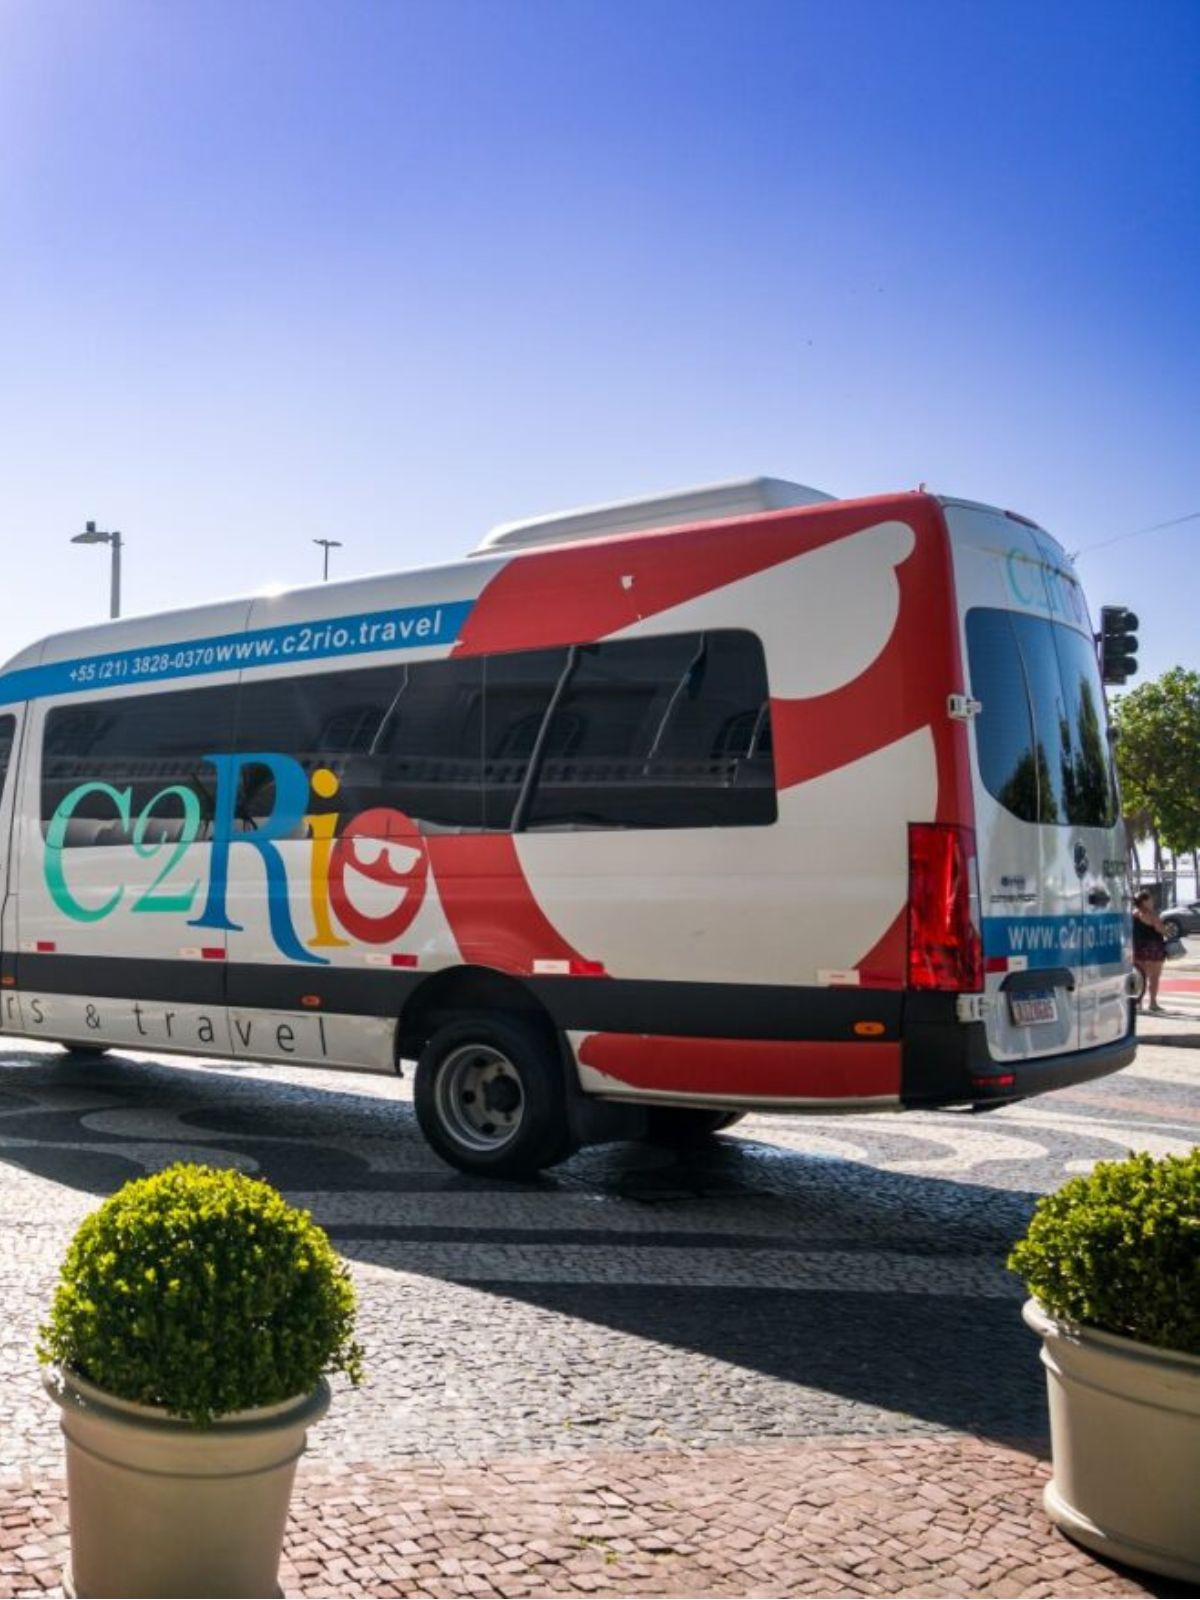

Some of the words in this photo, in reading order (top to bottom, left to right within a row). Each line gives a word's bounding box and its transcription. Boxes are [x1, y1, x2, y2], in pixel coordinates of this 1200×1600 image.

[70, 664, 96, 682] +55
[100, 660, 128, 678] (21)
[132, 648, 214, 675] 3828-0370
[216, 610, 442, 661] www.c2rio.travel
[43, 752, 428, 965] C2Rio
[1007, 918, 1126, 951] www.c2rio.trav
[86, 1003, 101, 1030] &
[134, 1002, 327, 1056] travel
